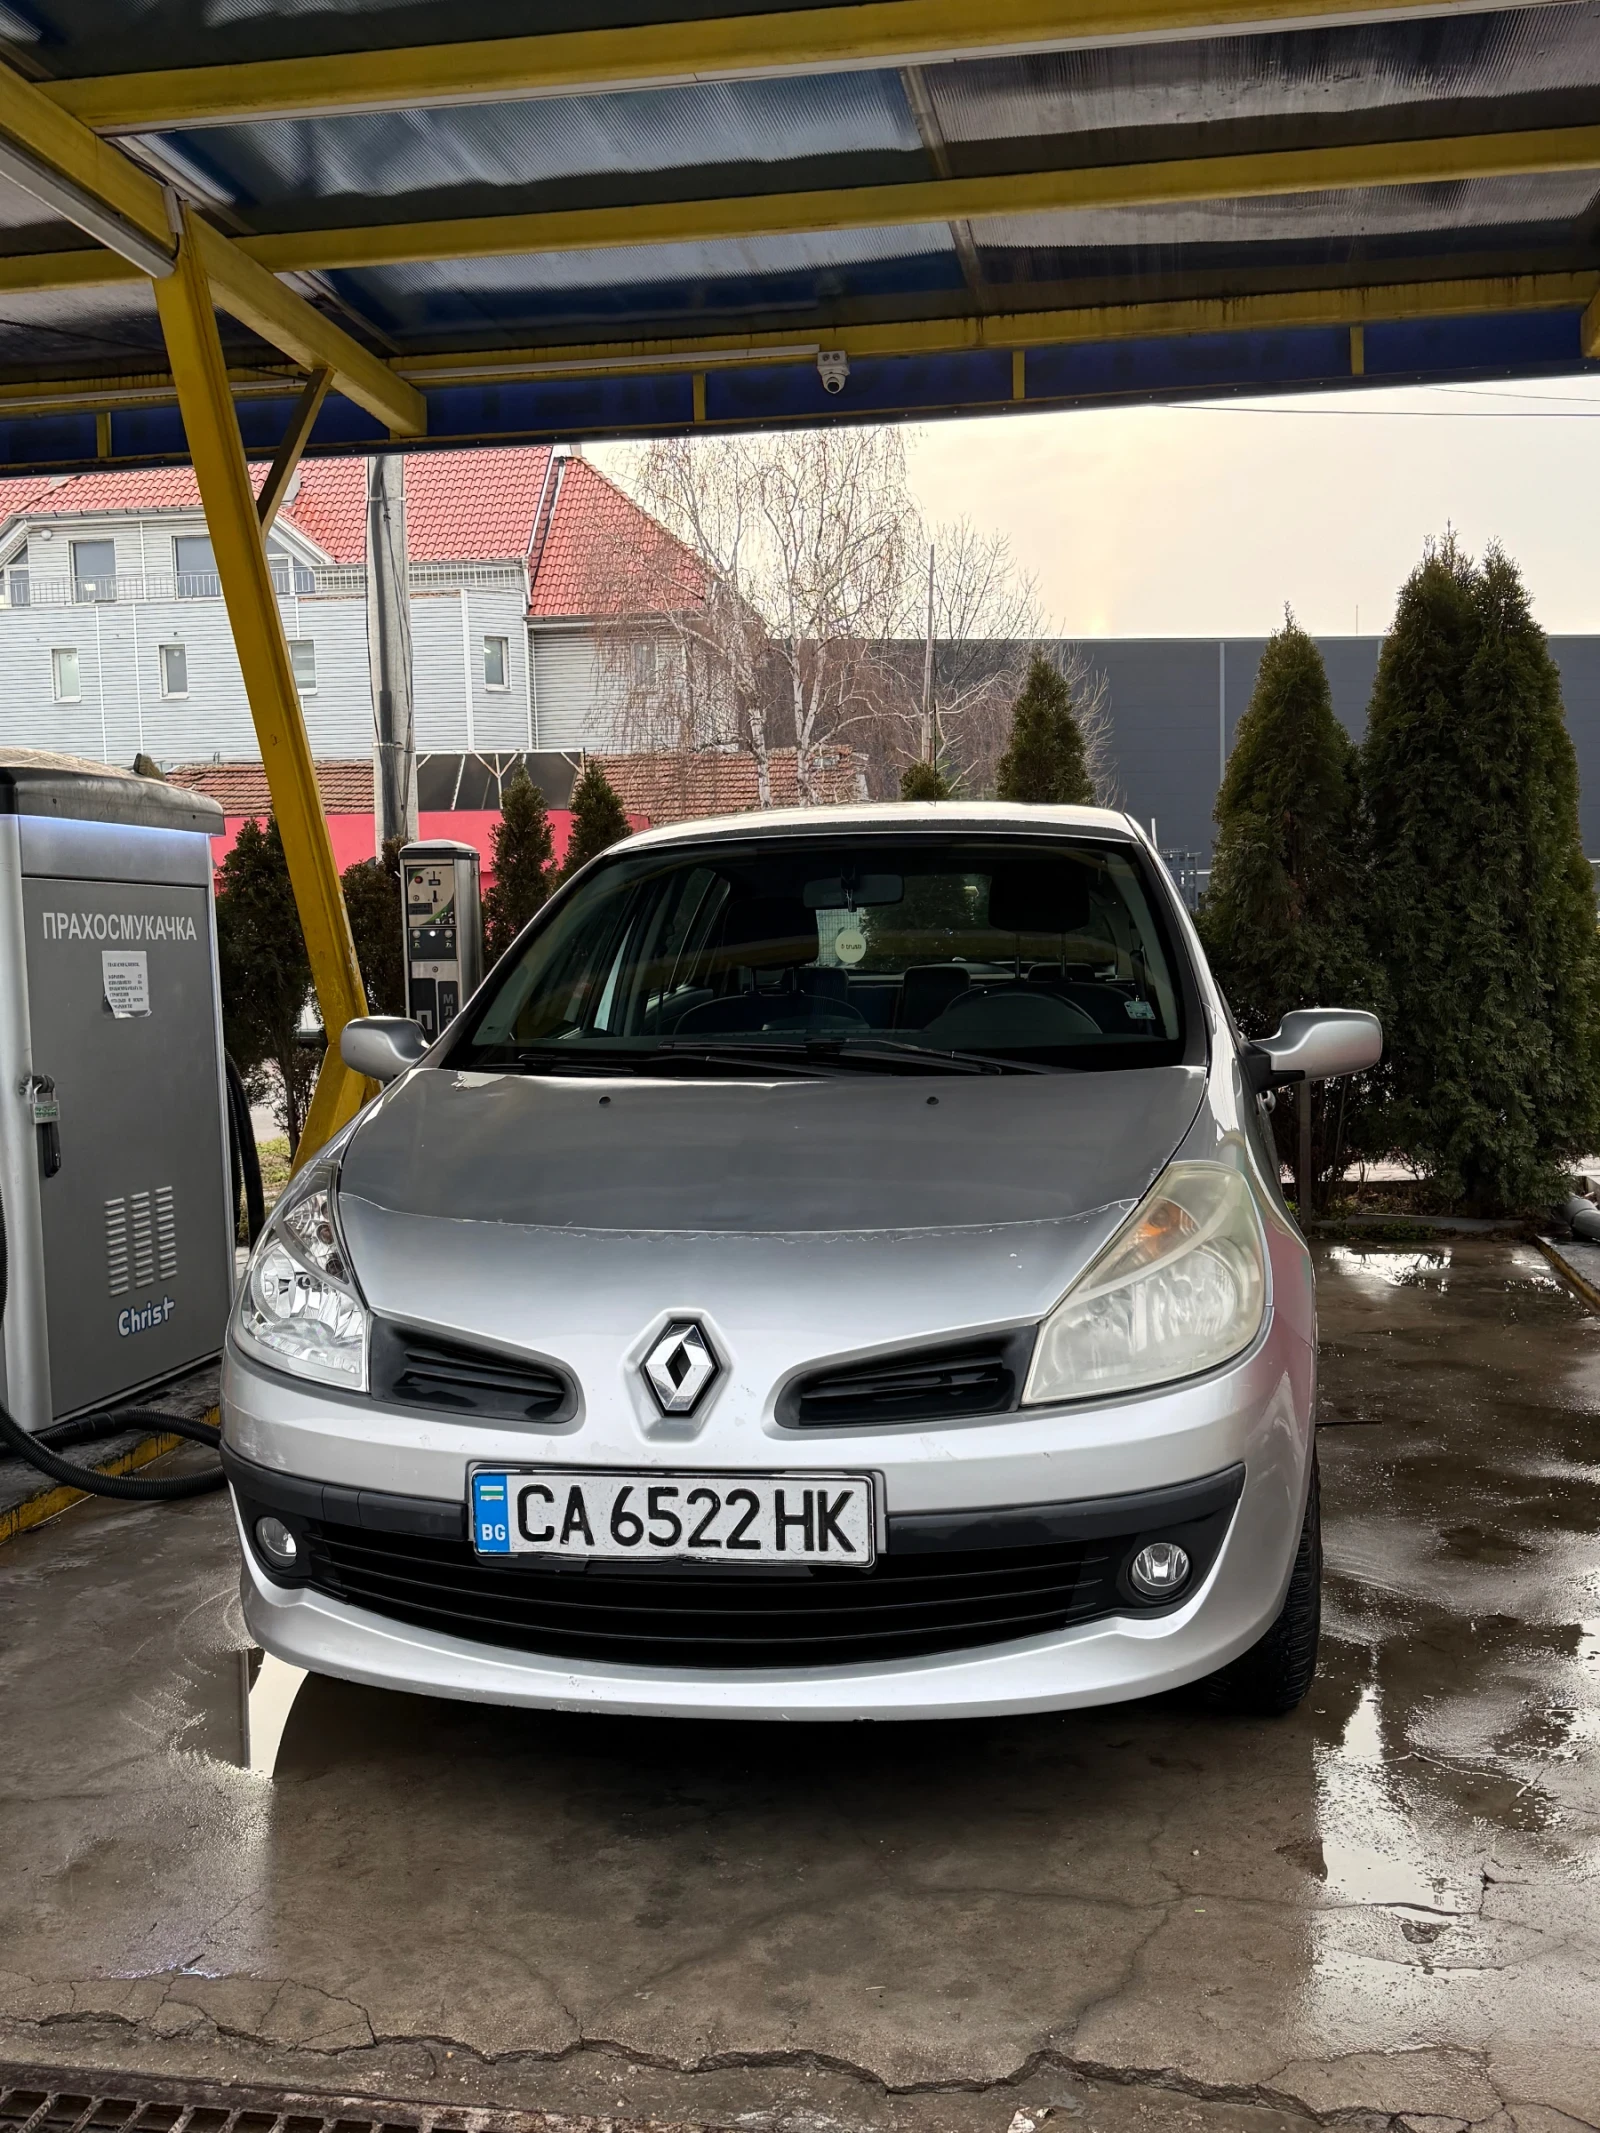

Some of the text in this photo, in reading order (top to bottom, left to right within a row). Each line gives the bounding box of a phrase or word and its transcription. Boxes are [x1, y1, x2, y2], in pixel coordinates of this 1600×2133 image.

[42, 912, 198, 941] ПРАХОСМУКАЧКА
[118, 1295, 175, 1336] Christ
[481, 1523, 506, 1541] BG
[610, 1486, 762, 1550] 6522
